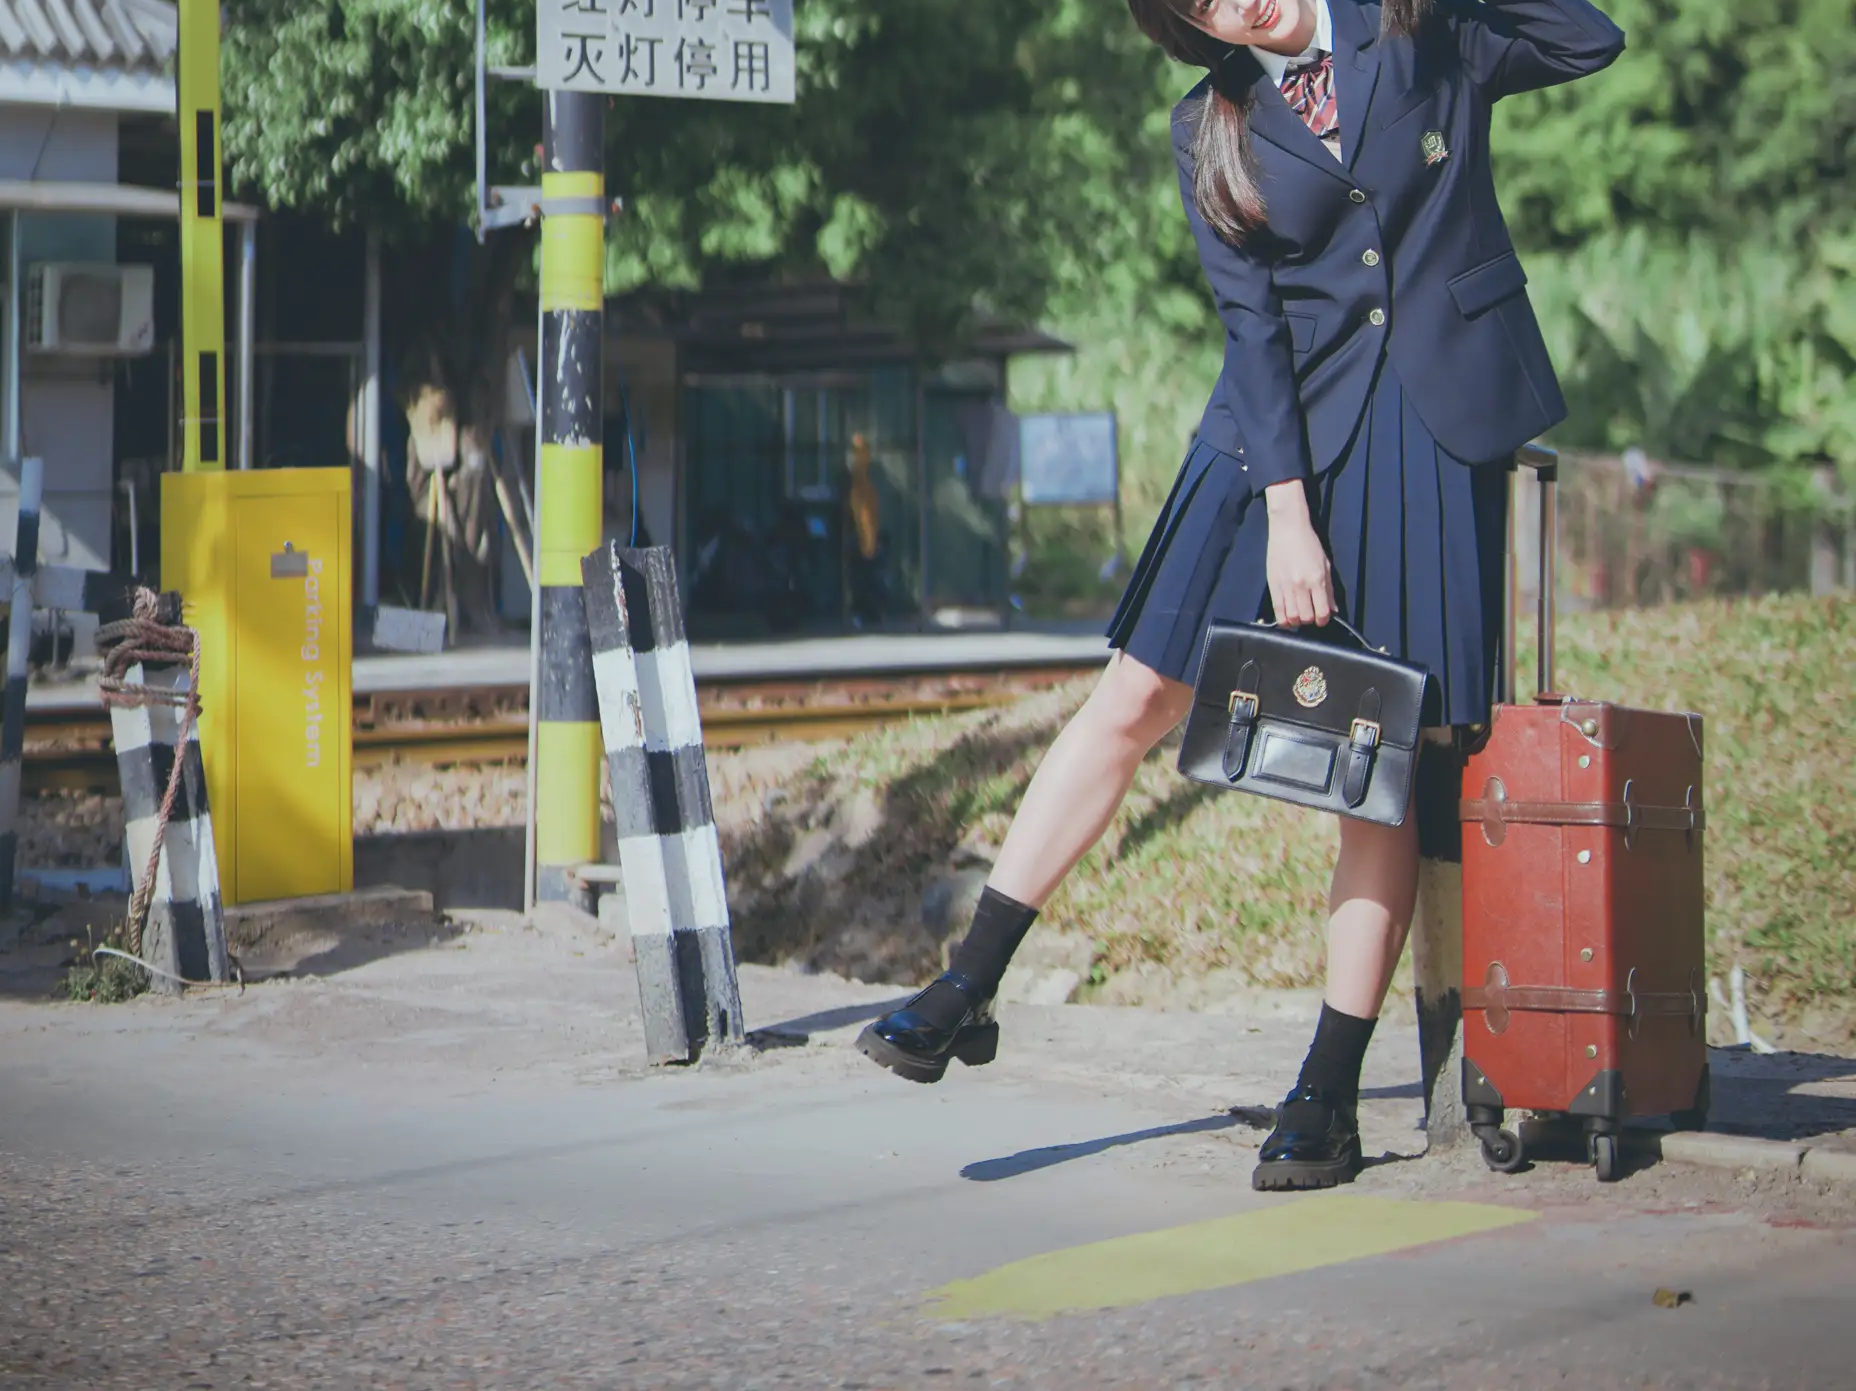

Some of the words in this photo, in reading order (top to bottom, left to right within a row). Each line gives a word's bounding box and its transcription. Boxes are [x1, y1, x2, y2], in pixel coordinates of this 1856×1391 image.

[561, 33, 770, 92] 灭灯停用
[301, 558, 323, 661] Parking
[301, 669, 323, 767] System
